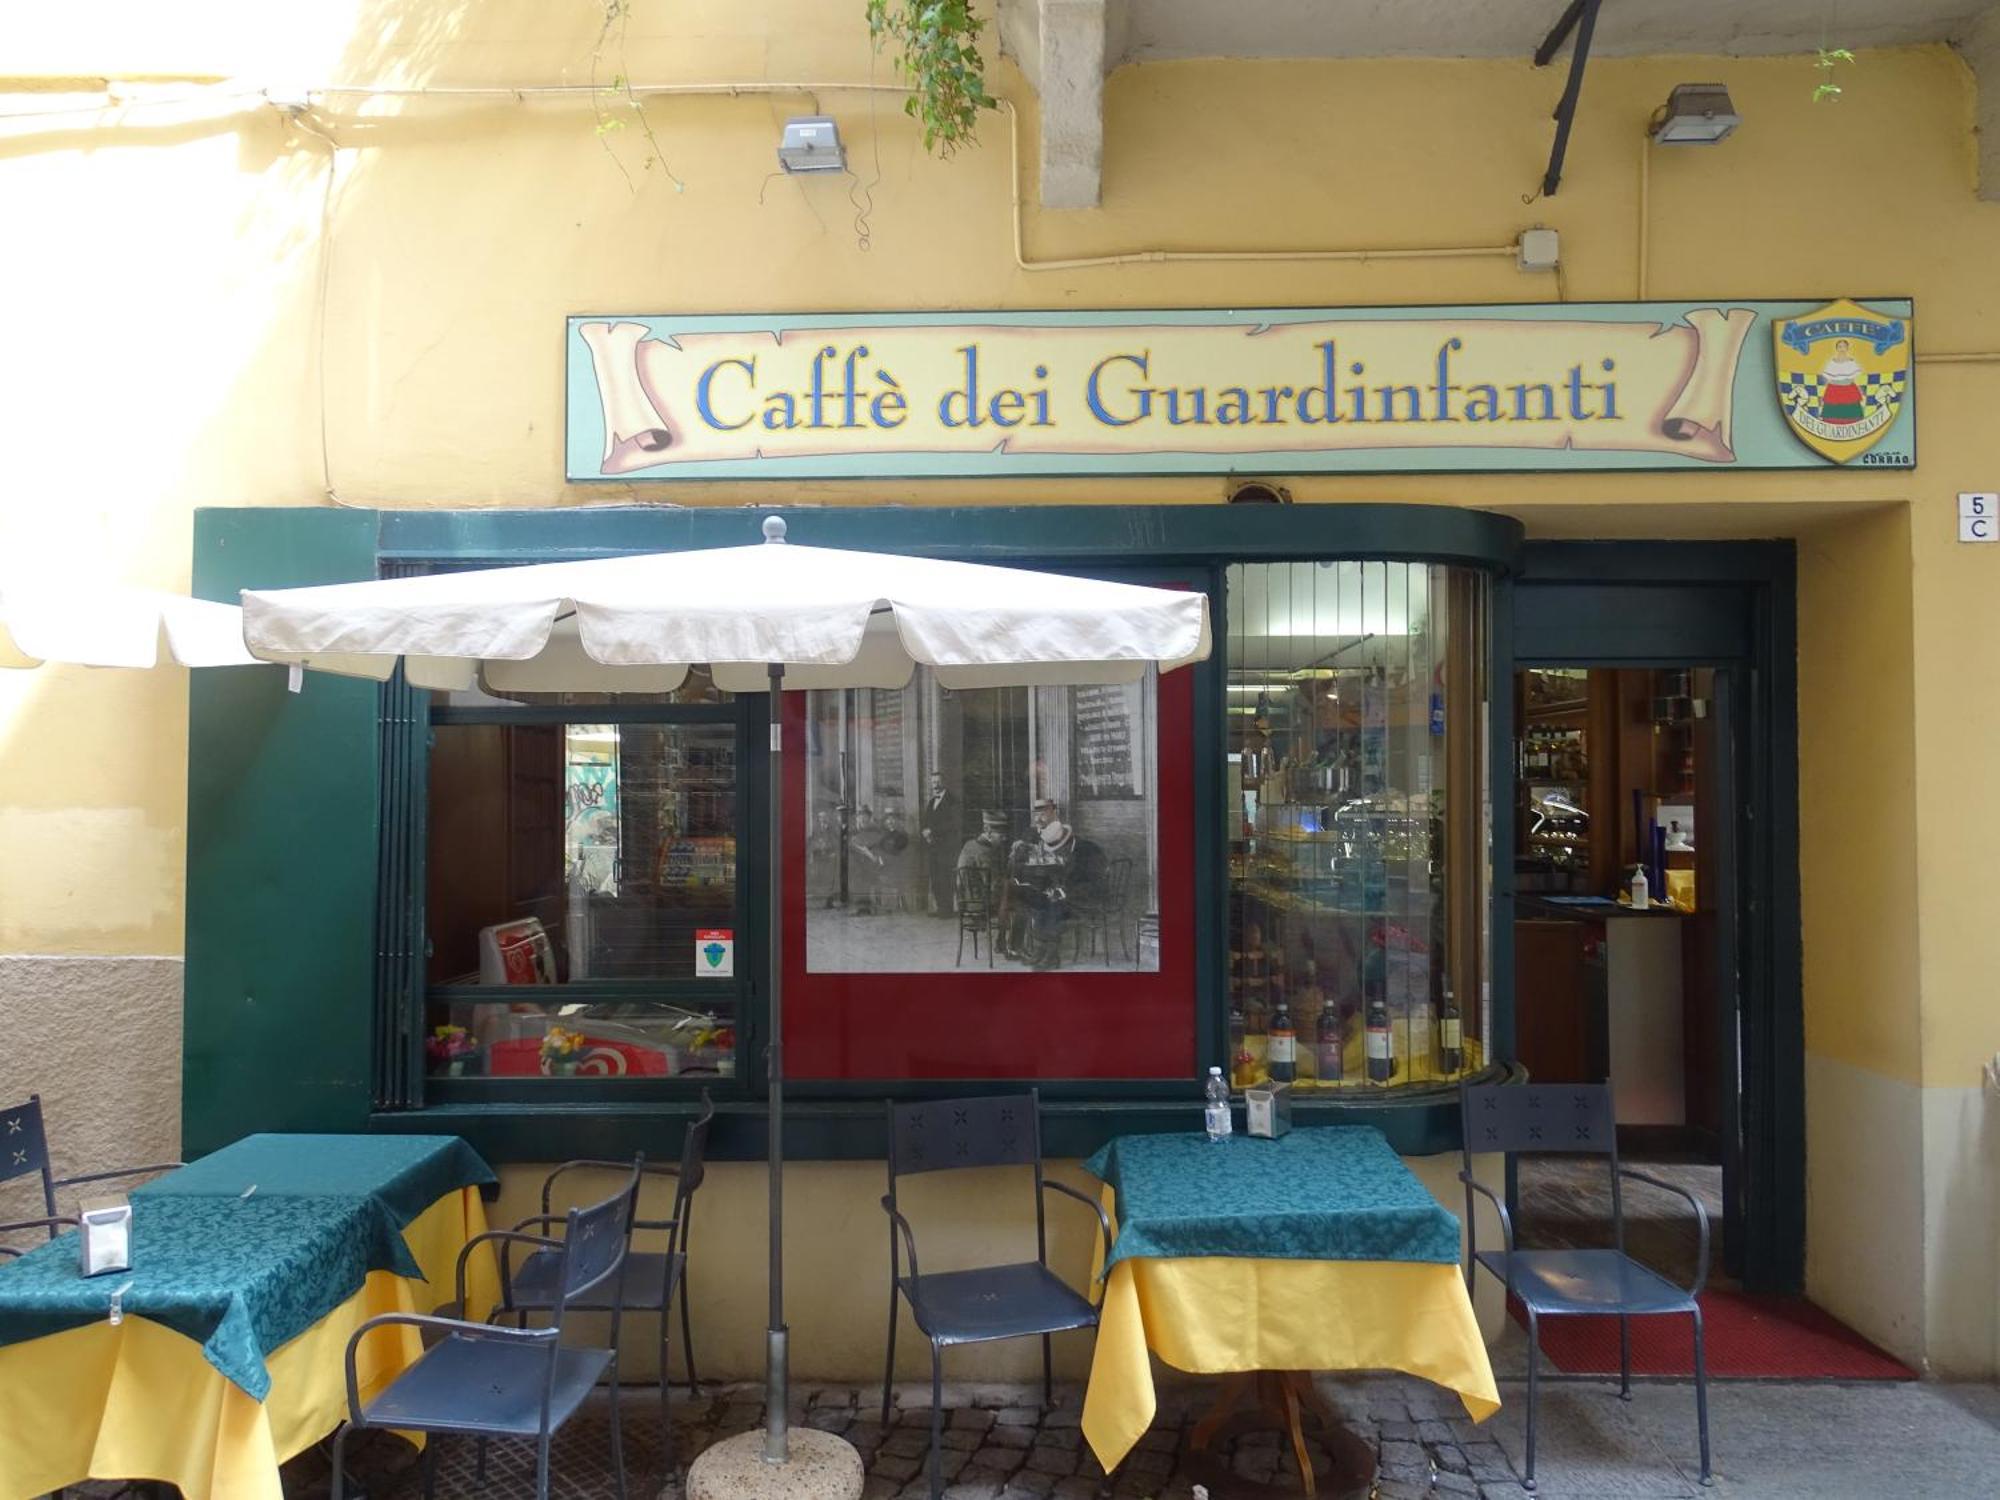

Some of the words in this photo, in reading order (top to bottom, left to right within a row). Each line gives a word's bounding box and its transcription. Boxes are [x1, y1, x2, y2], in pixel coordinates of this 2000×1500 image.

[695, 345, 907, 430] Caffè
[939, 344, 1056, 428] dei
[1086, 337, 1623, 427] Guardinfanti
[1972, 496, 1984, 514] 5
[1971, 519, 1987, 537] C
